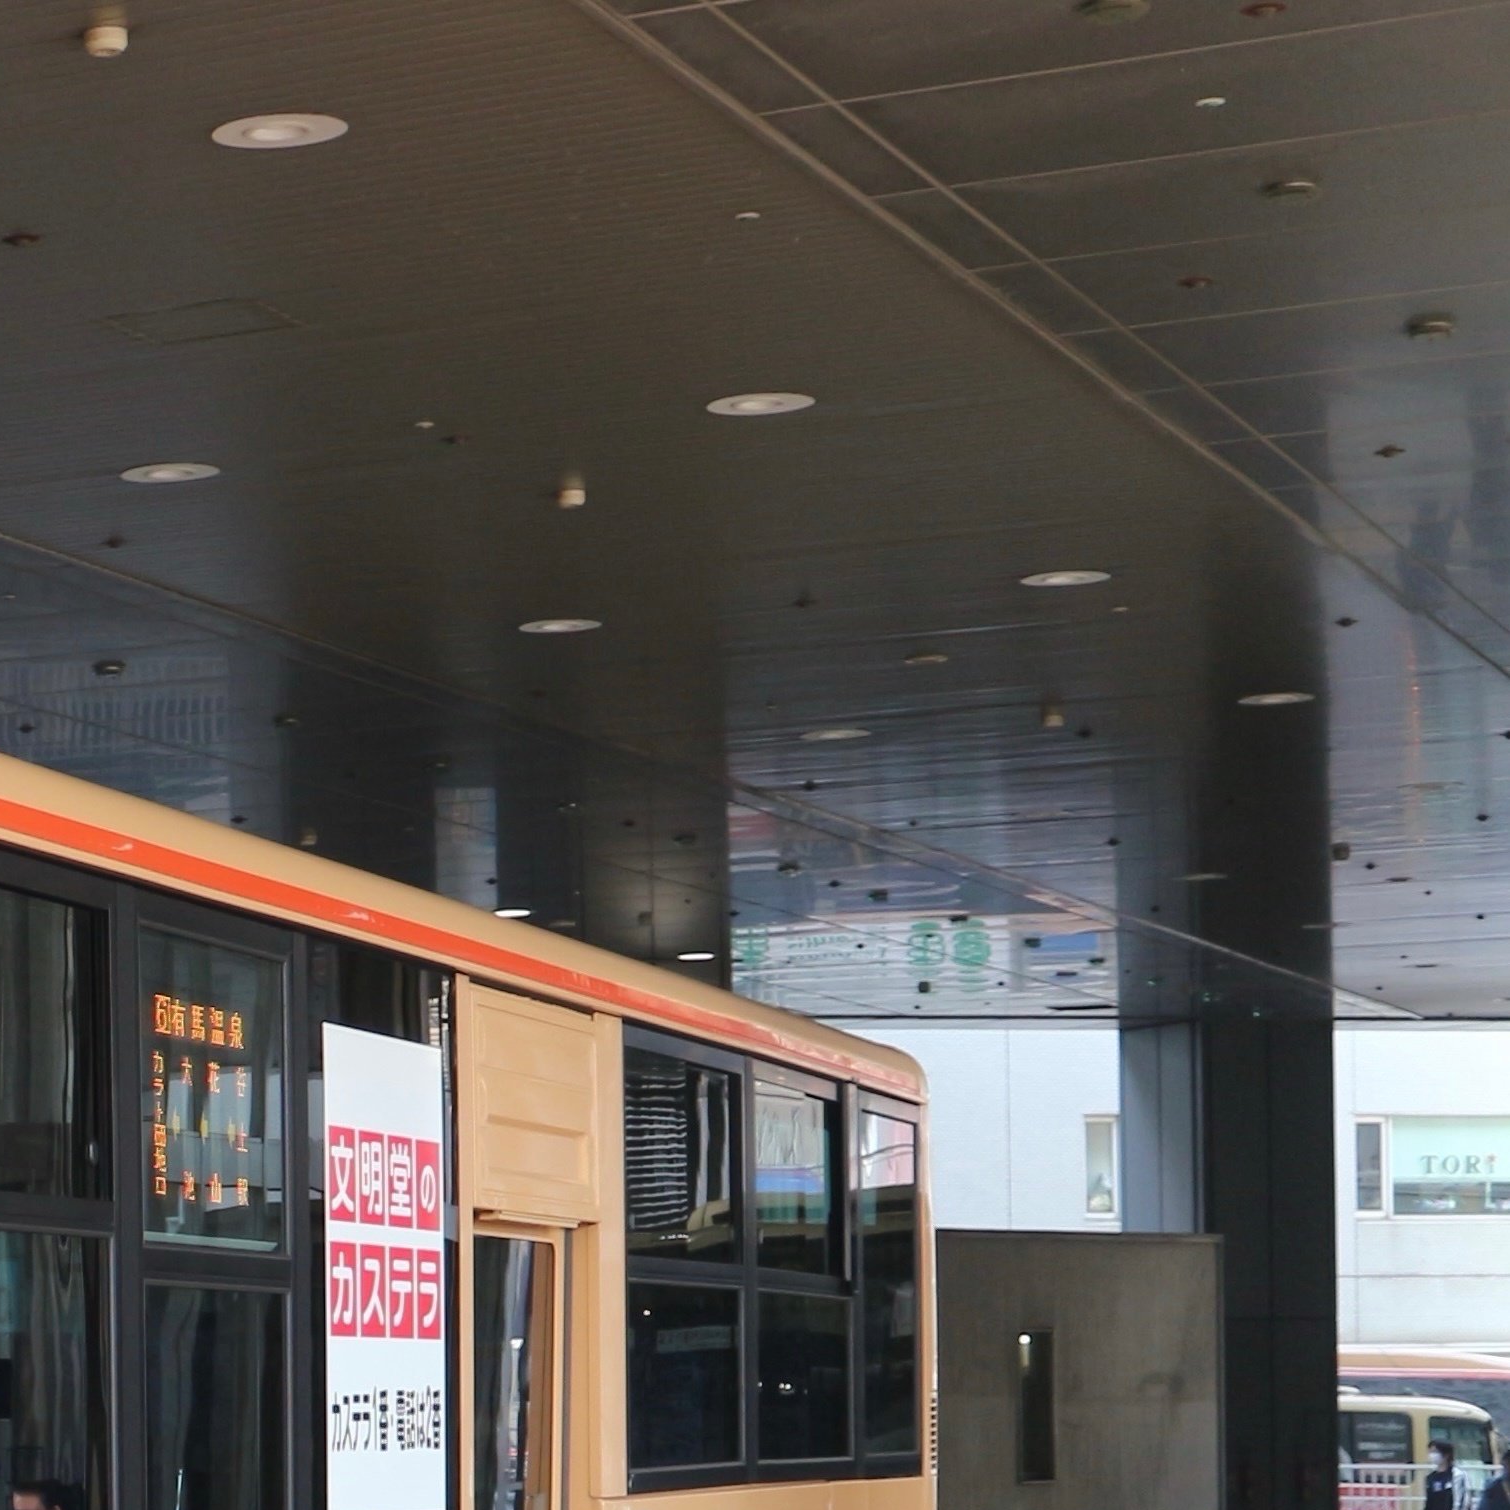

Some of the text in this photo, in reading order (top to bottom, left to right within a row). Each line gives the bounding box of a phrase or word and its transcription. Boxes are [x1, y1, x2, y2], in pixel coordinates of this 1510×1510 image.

[330, 1132, 437, 1219] 文明堂の
[332, 1250, 439, 1329] カステラ
